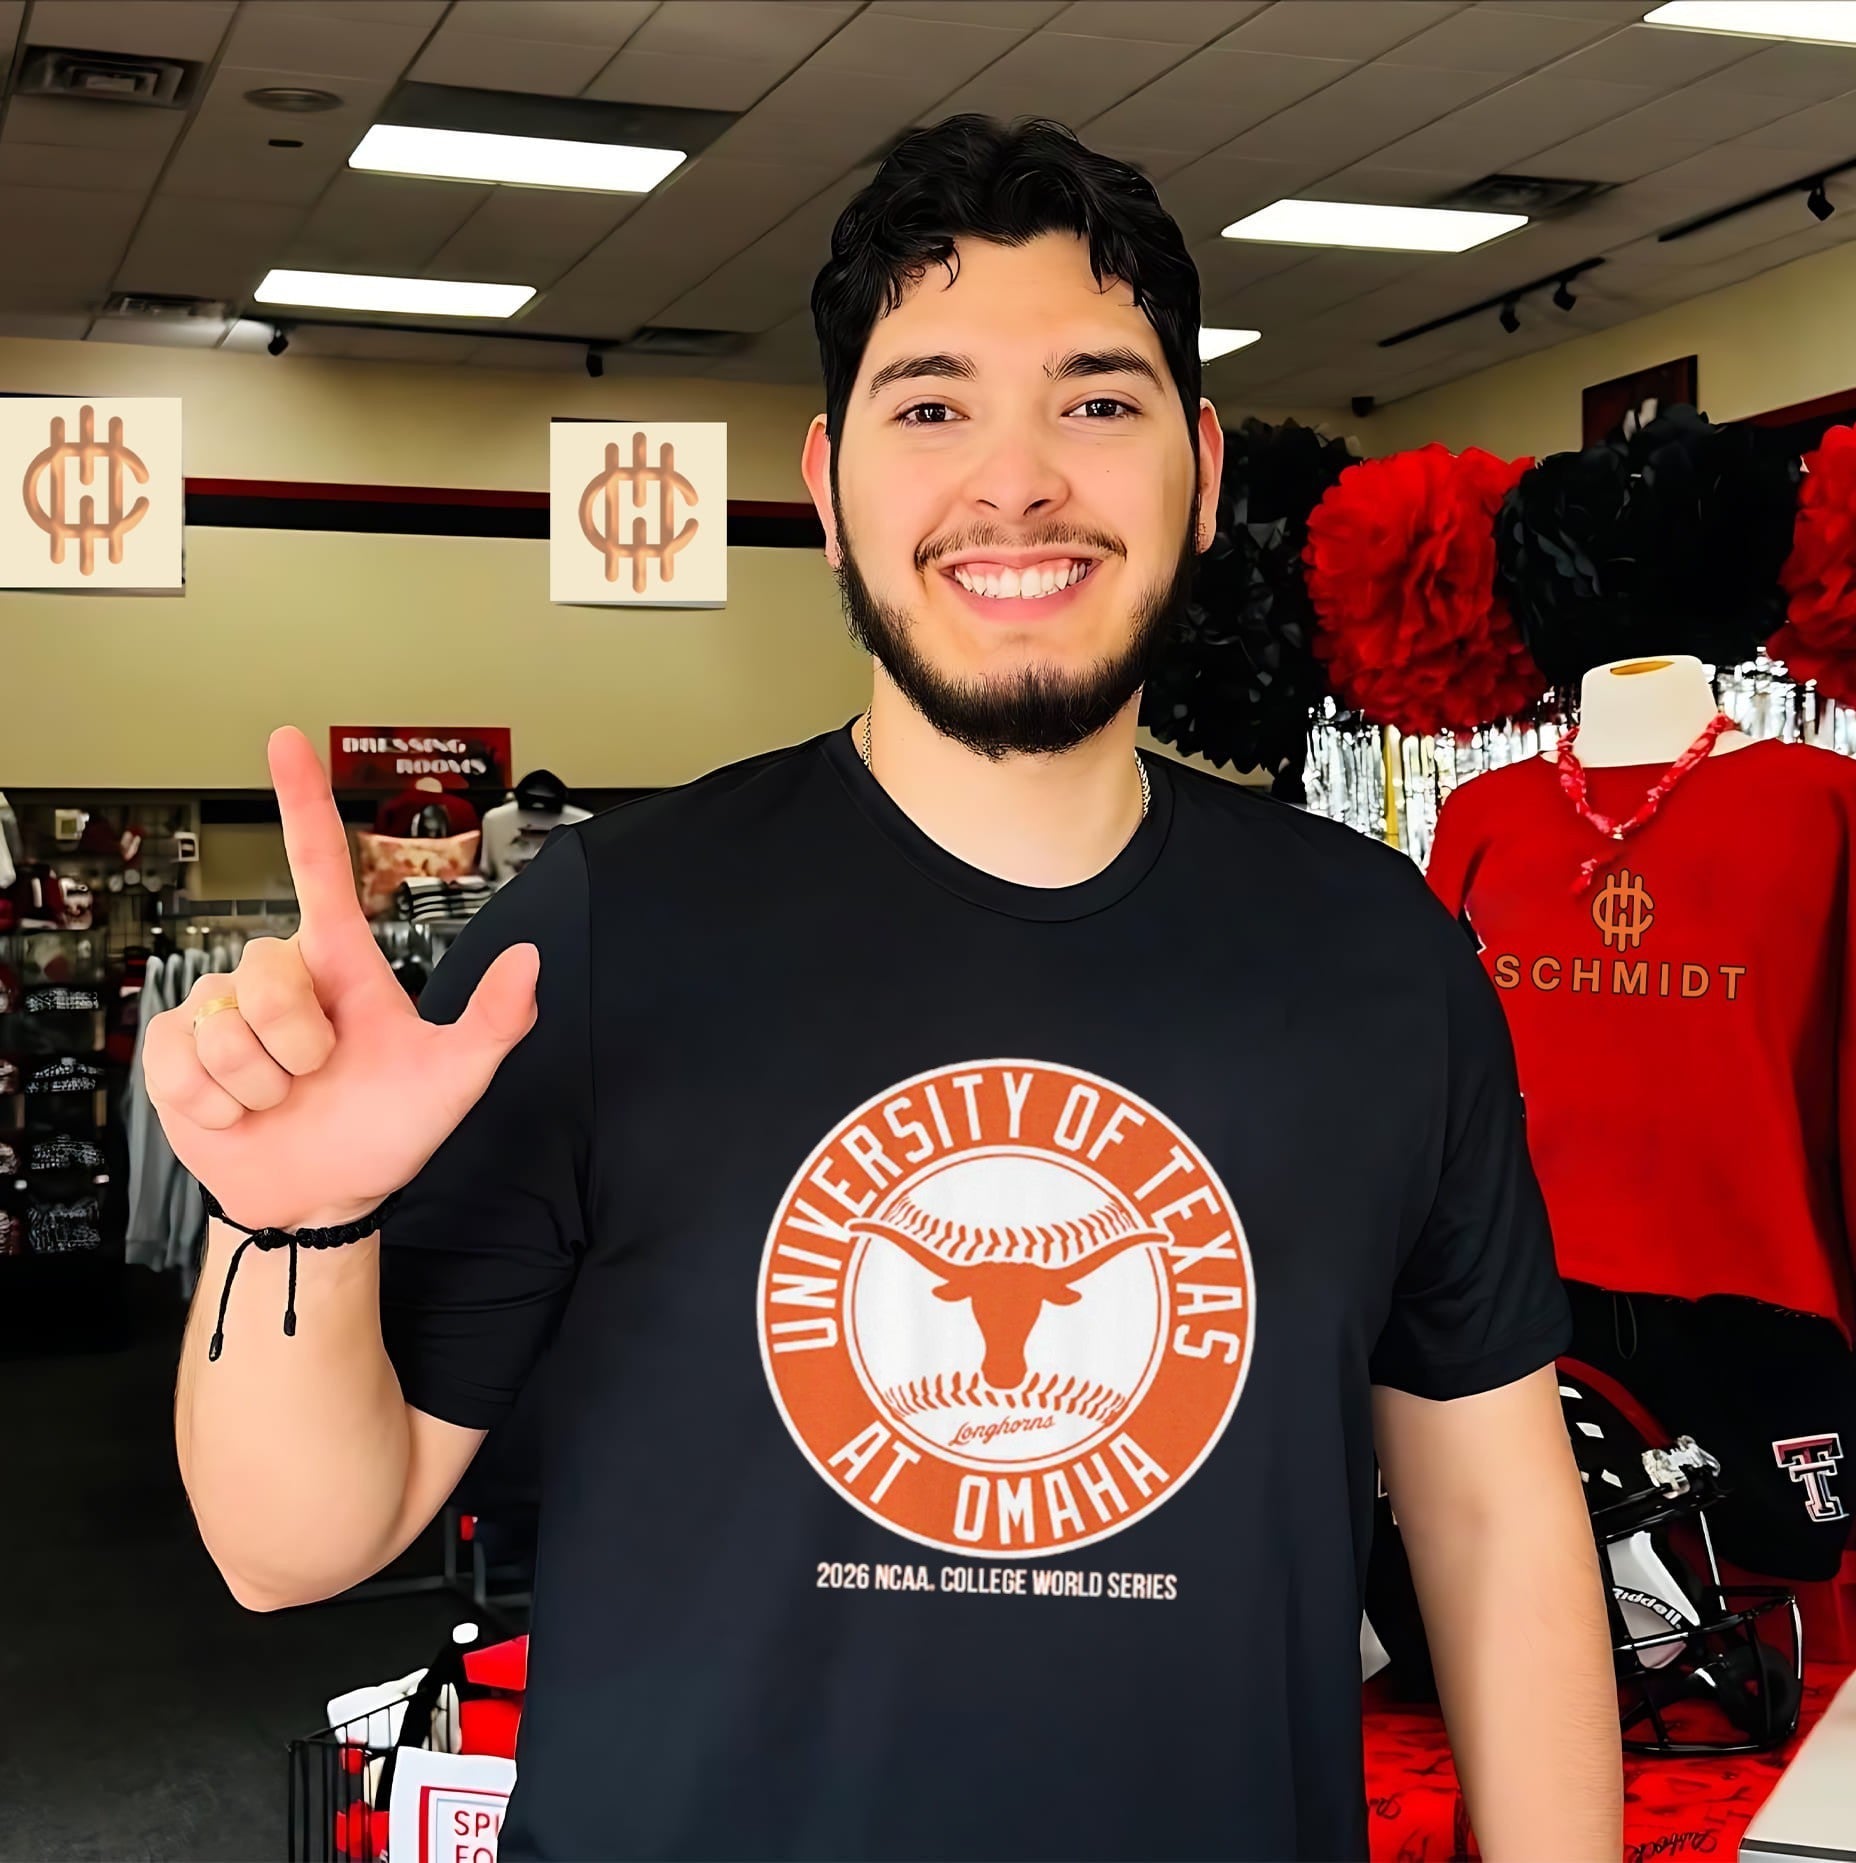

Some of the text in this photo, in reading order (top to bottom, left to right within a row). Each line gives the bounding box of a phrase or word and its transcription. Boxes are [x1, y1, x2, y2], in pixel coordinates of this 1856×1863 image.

[396, 758, 487, 775] ROOMS
[1494, 954, 1747, 1000] SCHMIDT
[770, 1072, 1243, 1365] UNIVERSITY OF TEXAS
[948, 1415, 1056, 1447] Longhorns
[827, 1420, 1170, 1546] AT OMAHA
[816, 1562, 870, 1589] 2026
[940, 1566, 1027, 1595] COLLEGE
[1032, 1569, 1103, 1598] WORLD
[1107, 1572, 1178, 1600] SERIES
